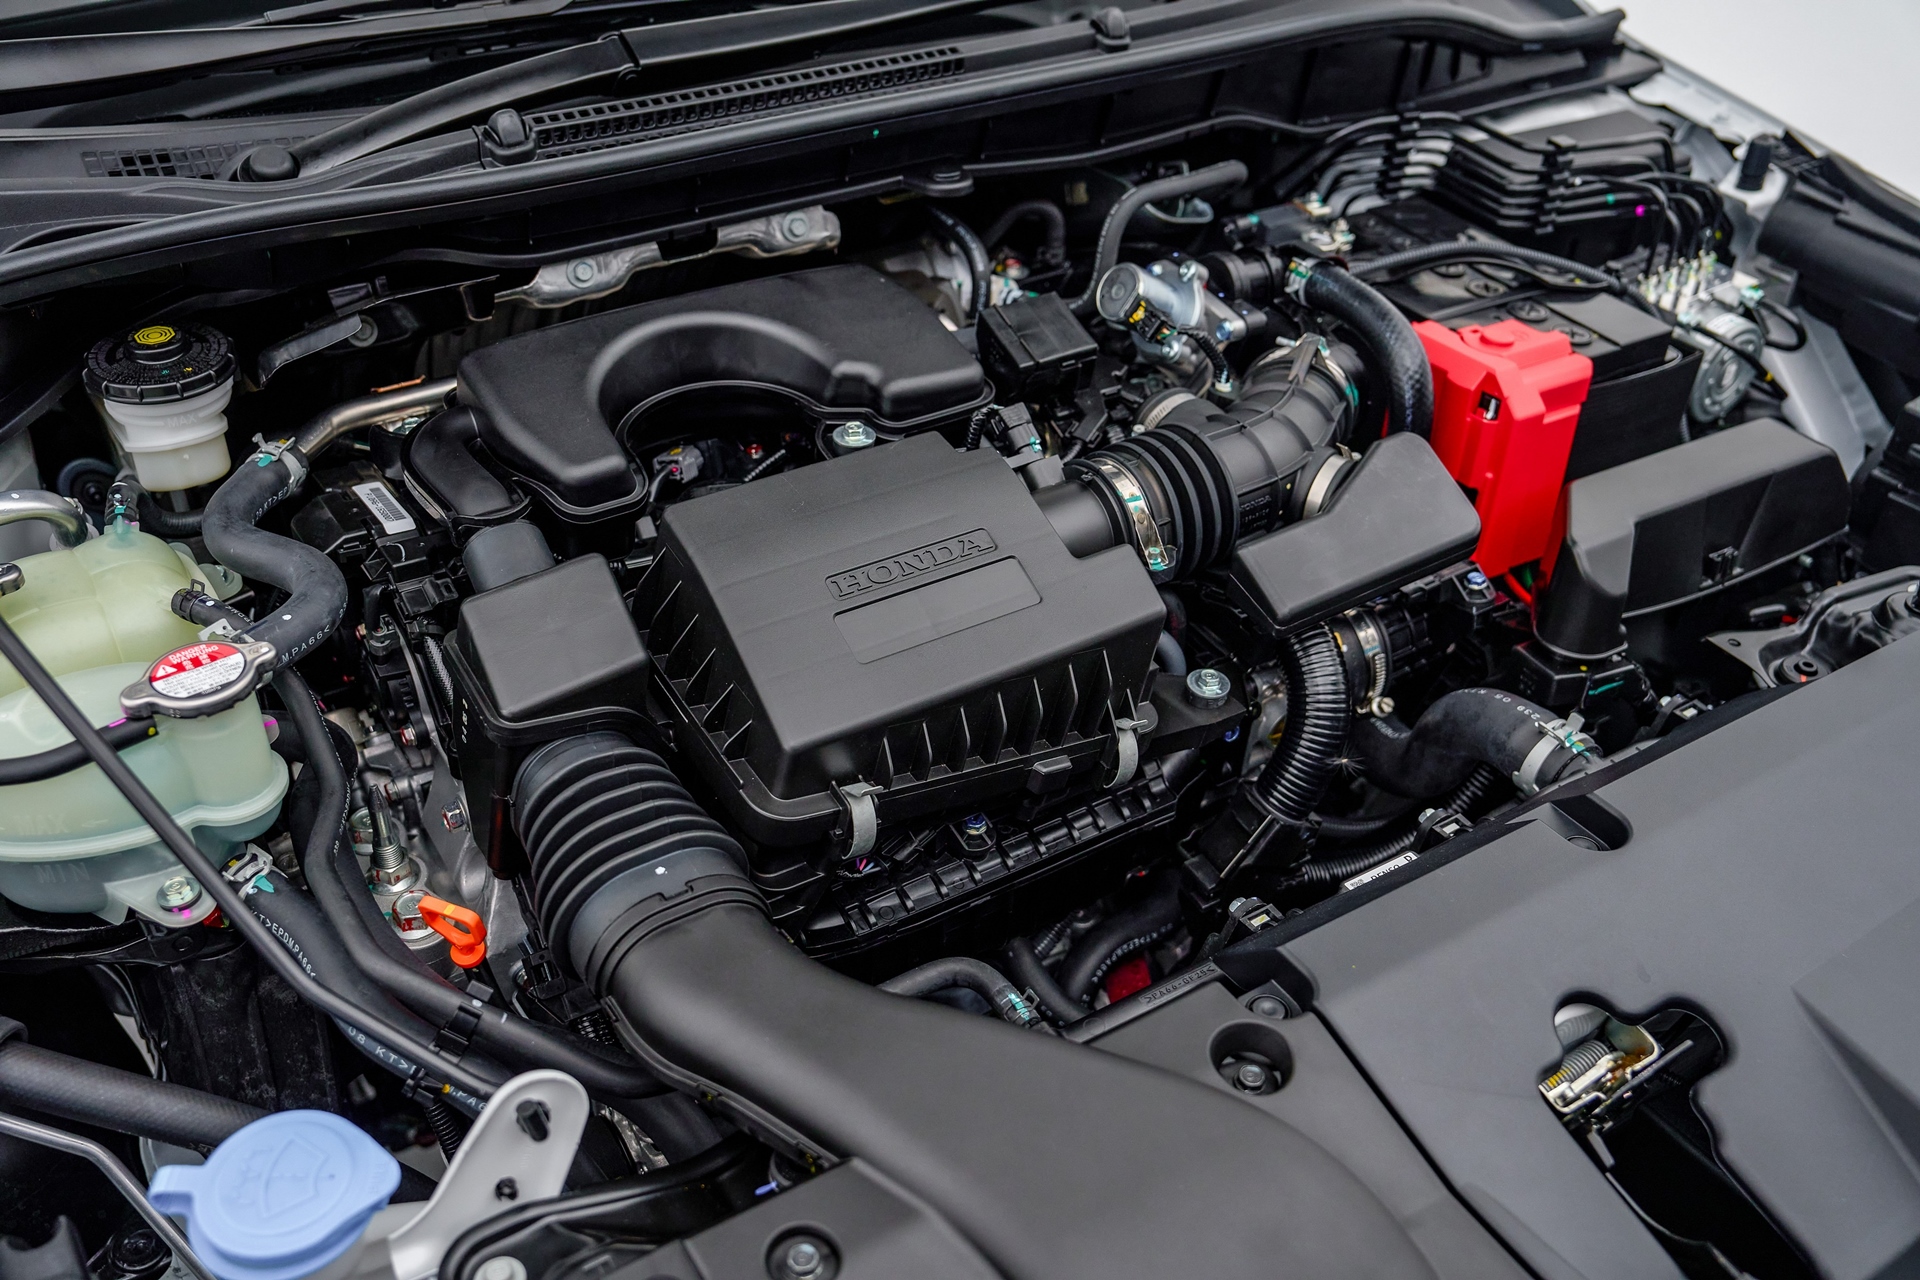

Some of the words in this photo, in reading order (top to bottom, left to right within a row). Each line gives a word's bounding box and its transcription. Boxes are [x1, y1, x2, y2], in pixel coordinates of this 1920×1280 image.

[831, 539, 994, 598] HONDA
[168, 644, 207, 661] DANGER
[172, 645, 219, 664] WARNUNG
[33, 862, 91, 884] MIN
